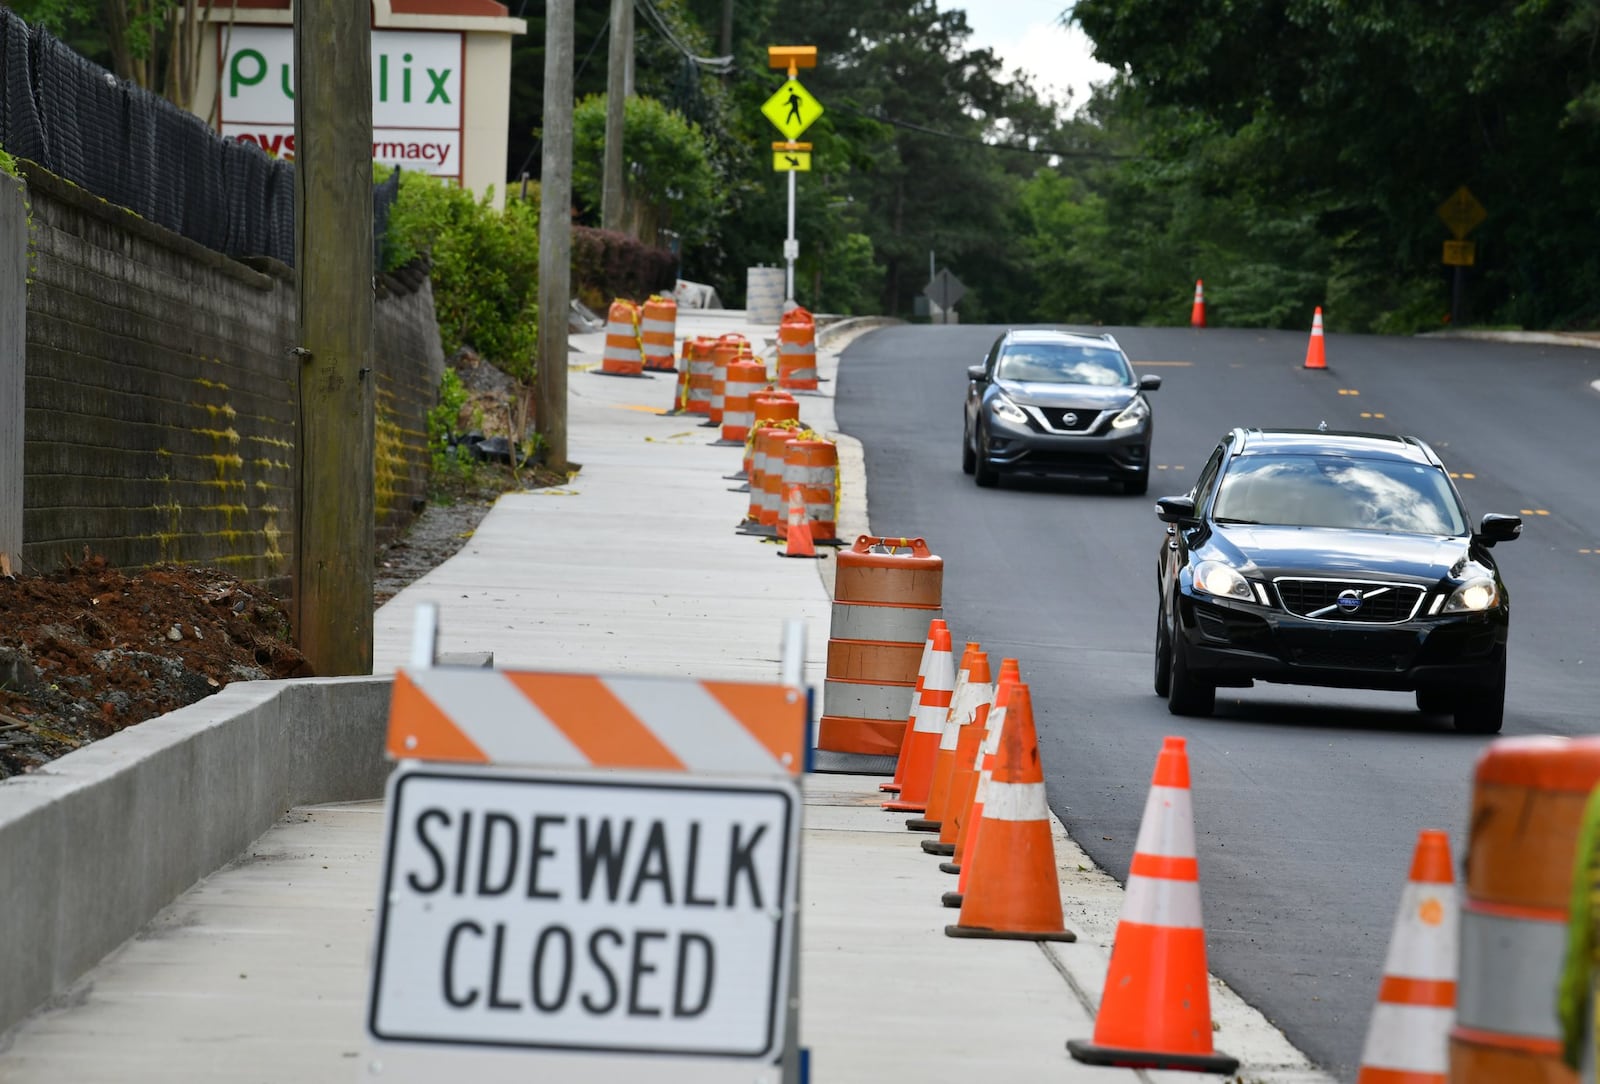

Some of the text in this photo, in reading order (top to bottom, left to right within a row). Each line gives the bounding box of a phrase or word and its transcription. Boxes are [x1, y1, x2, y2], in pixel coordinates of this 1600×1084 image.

[230, 49, 451, 104] Pulix
[372, 142, 450, 166] rmacy
[406, 808, 769, 910] SIDEWALK
[442, 920, 715, 1020] CLOSED
